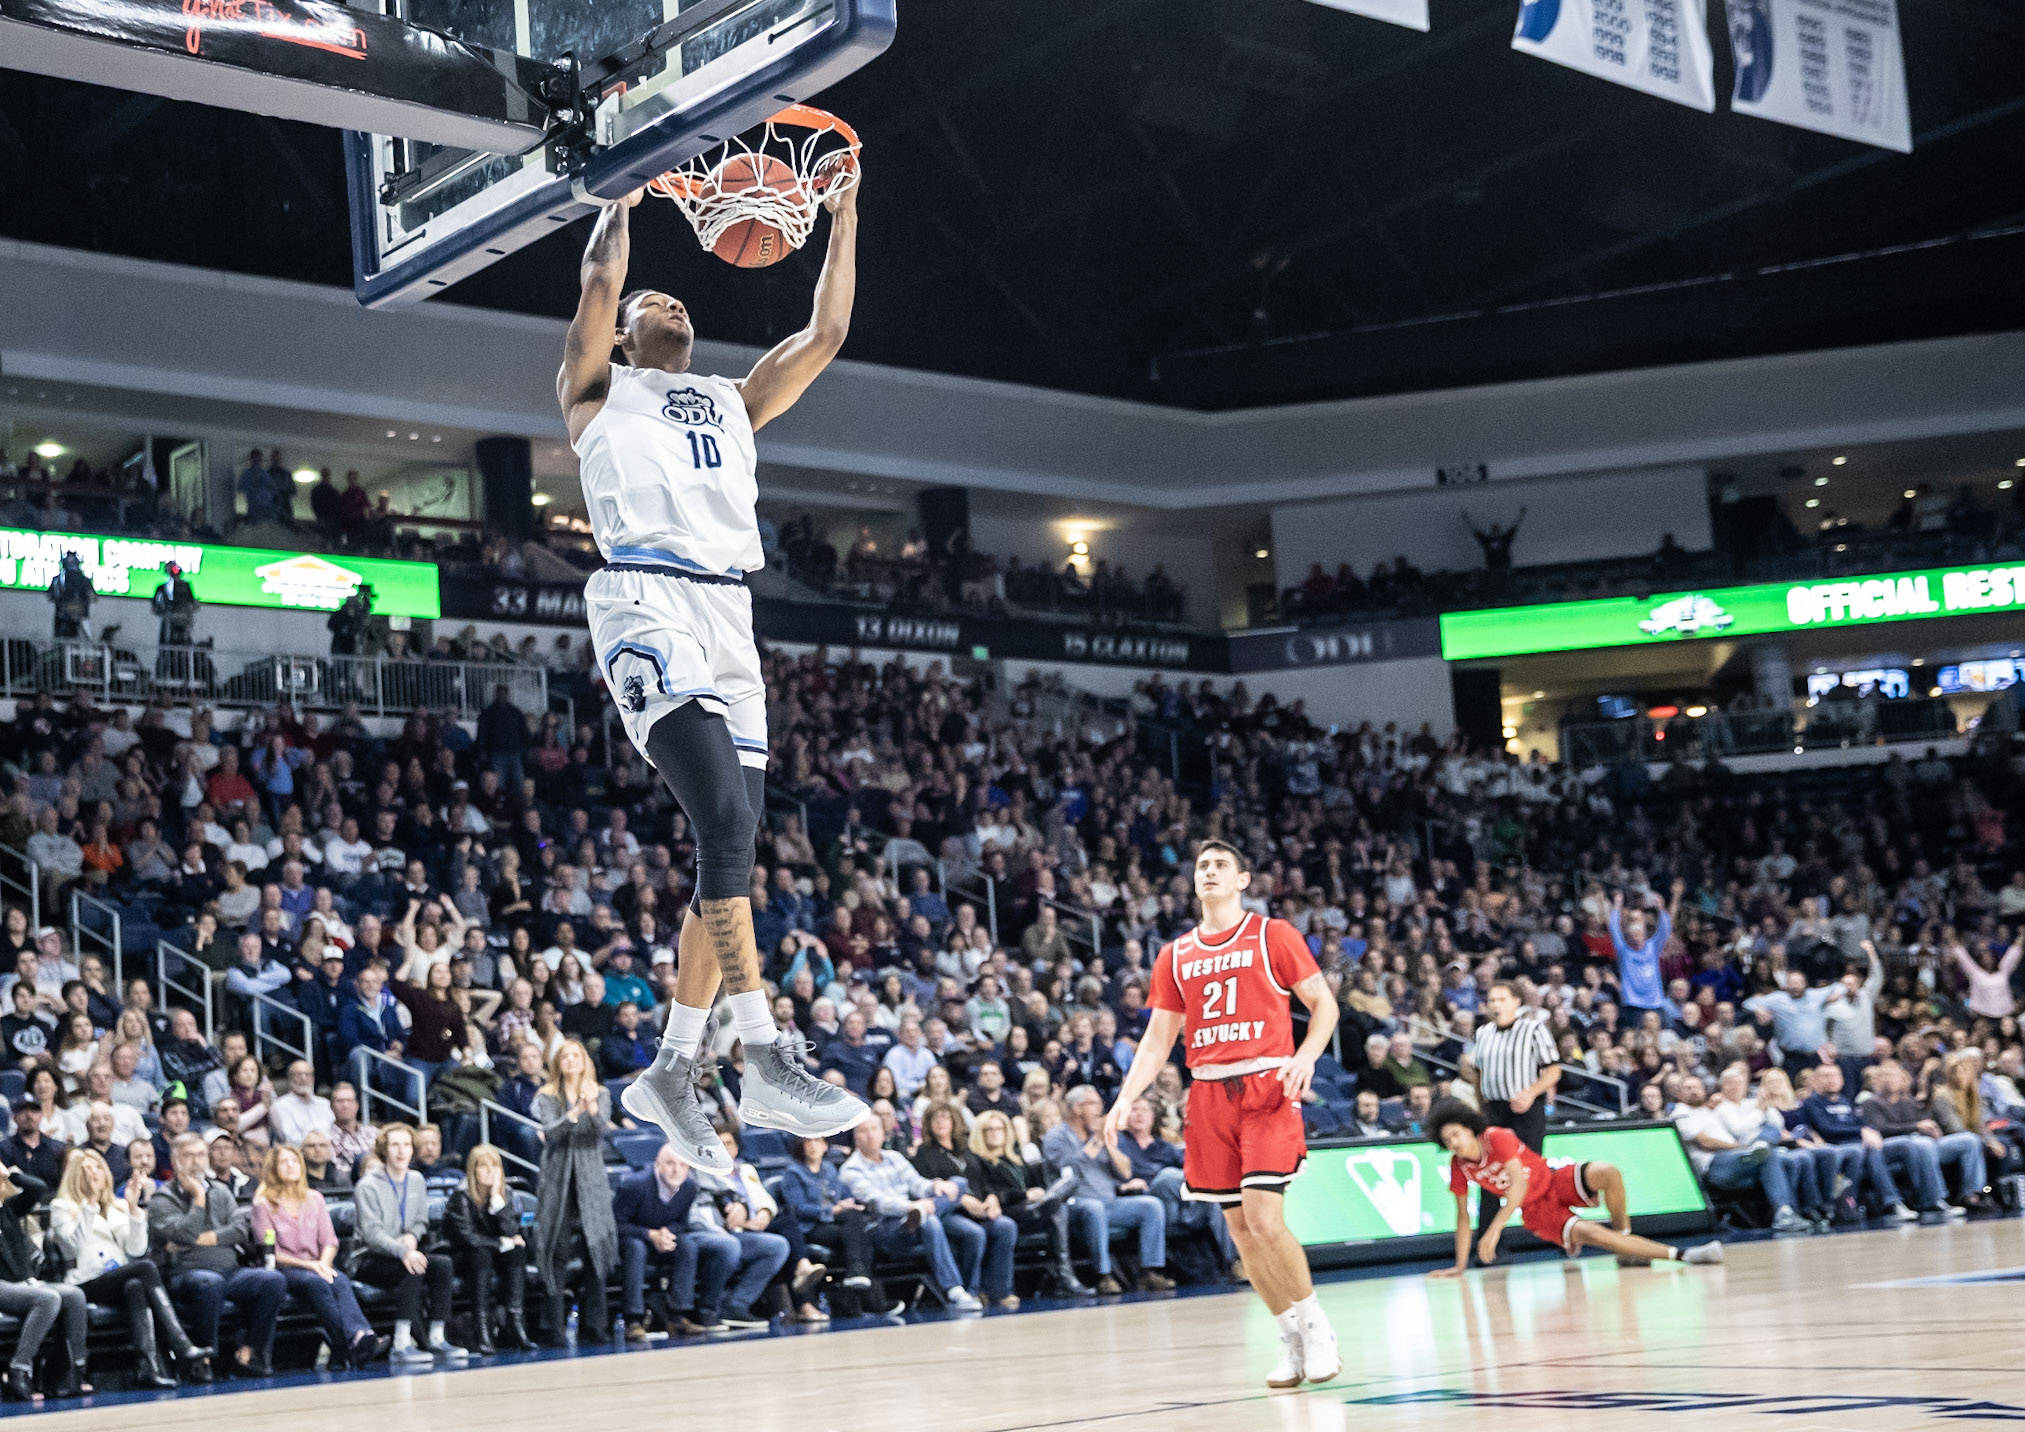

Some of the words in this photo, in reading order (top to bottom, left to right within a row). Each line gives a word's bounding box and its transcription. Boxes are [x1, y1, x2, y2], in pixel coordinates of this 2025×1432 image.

[686, 430, 721, 469] 10
[494, 587, 528, 614] 33
[536, 589, 587, 619] MA
[1787, 577, 1939, 624] OFFICIAL
[856, 616, 880, 639] 13
[888, 616, 960, 647] DIXON
[1064, 633, 1088, 655] 15
[1202, 976, 1238, 1020] 21
[1191, 1020, 1266, 1049] ENUCKY
